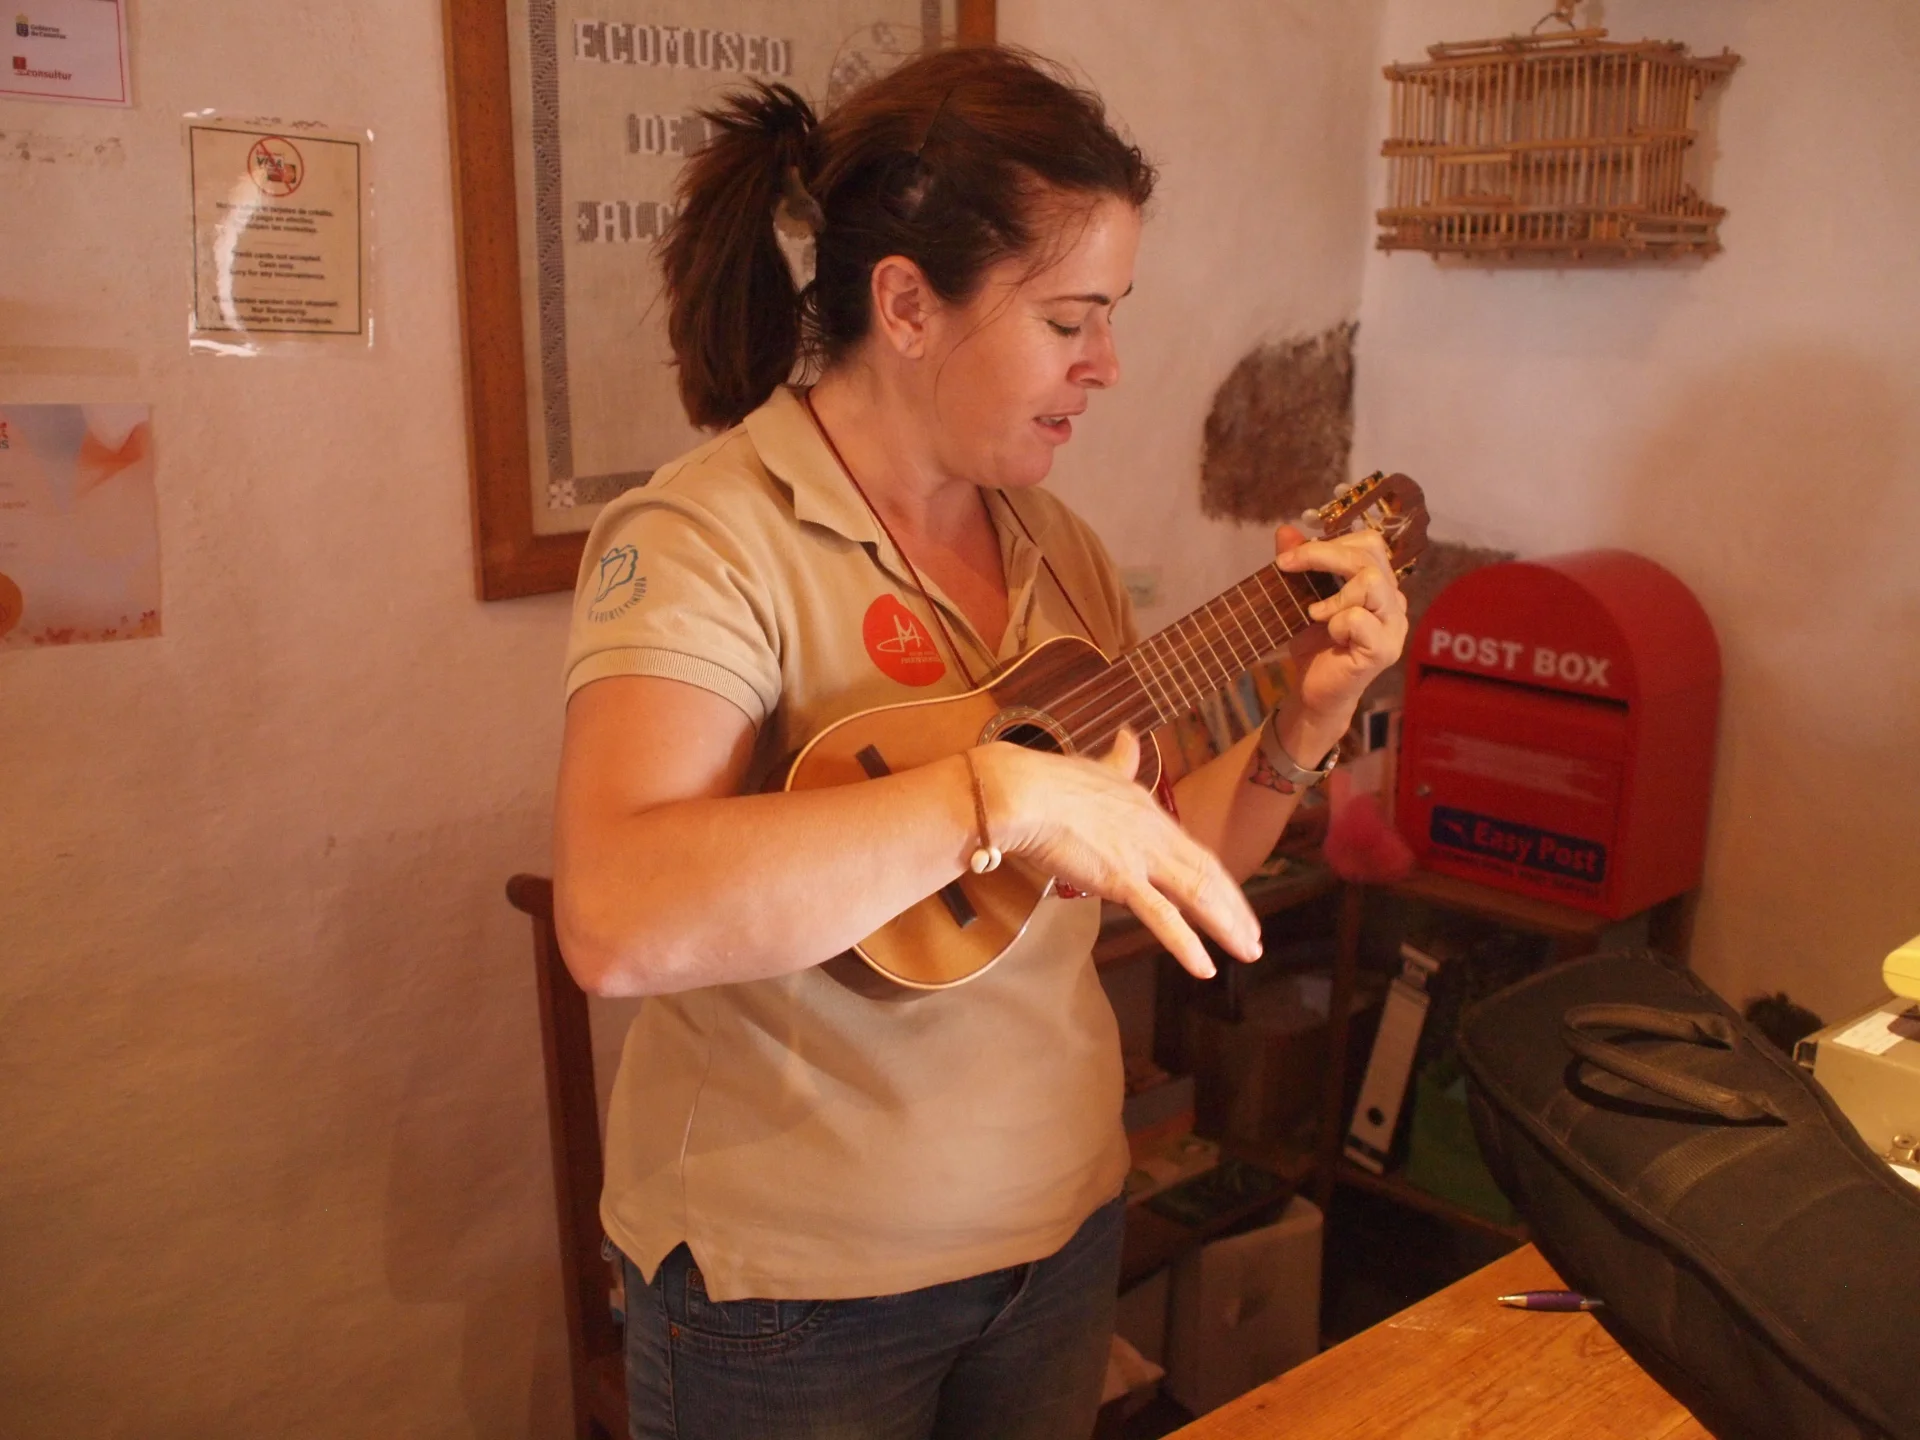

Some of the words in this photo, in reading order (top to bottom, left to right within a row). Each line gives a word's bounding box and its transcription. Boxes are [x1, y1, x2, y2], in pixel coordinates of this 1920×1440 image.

[573, 19, 790, 77] ECOMUSEO
[637, 114, 684, 156] DE
[1430, 628, 1524, 672] POST
[1532, 647, 1611, 688] BOX
[1472, 820, 1534, 864] Easy
[1539, 836, 1597, 874] Post
